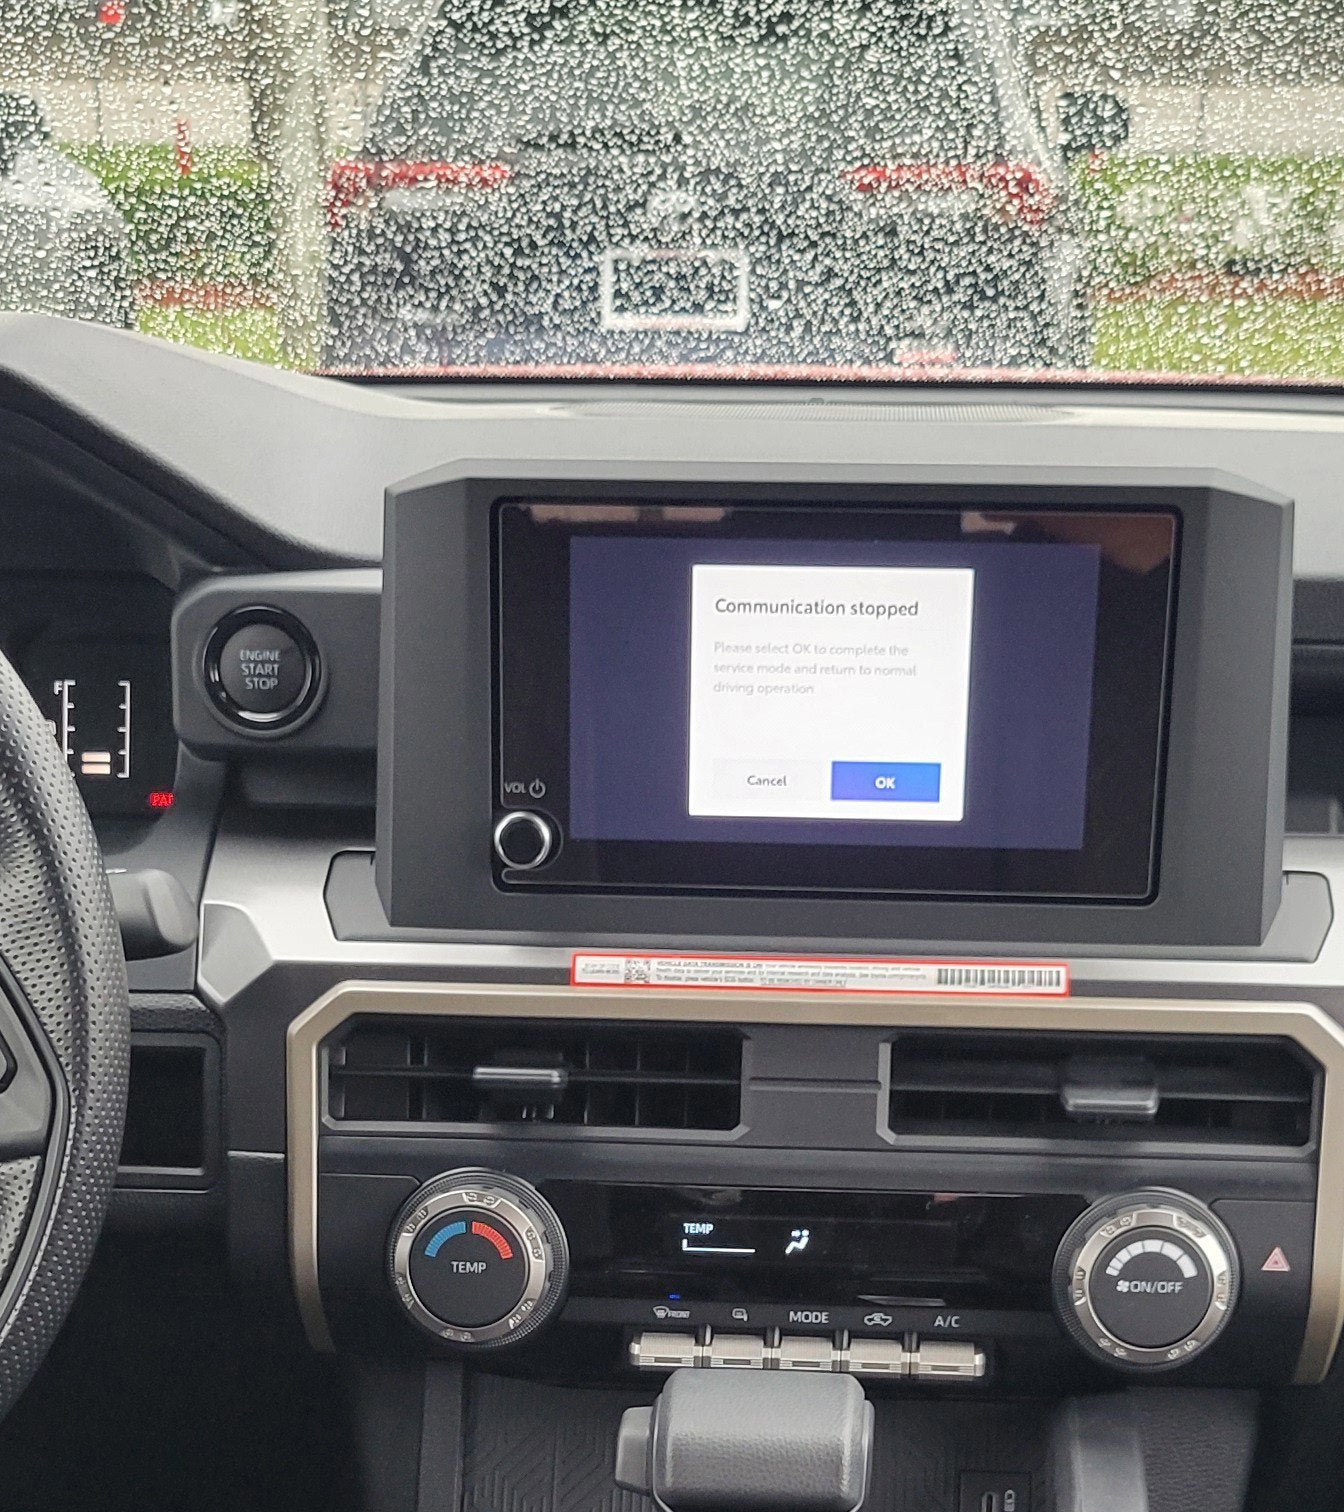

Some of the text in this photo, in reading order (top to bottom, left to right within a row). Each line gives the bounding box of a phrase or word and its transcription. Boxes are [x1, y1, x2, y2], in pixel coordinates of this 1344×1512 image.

[715, 598, 919, 620] Communication stopped
[240, 649, 281, 661] ENGINE
[714, 642, 909, 658] Please select OK to complete the
[241, 663, 279, 676] START
[713, 664, 916, 676] service mode and return to normal
[245, 677, 278, 690] STOP
[713, 682, 754, 695] driving
[747, 775, 787, 787] Cancel
[875, 777, 895, 789] OK
[505, 783, 526, 793] VOL
[683, 1222, 714, 1235] TEMP
[450, 1261, 487, 1274] TEMP
[1129, 1281, 1184, 1294] ON/OFF
[789, 1310, 829, 1324] MODE
[934, 1315, 960, 1329] A/C
